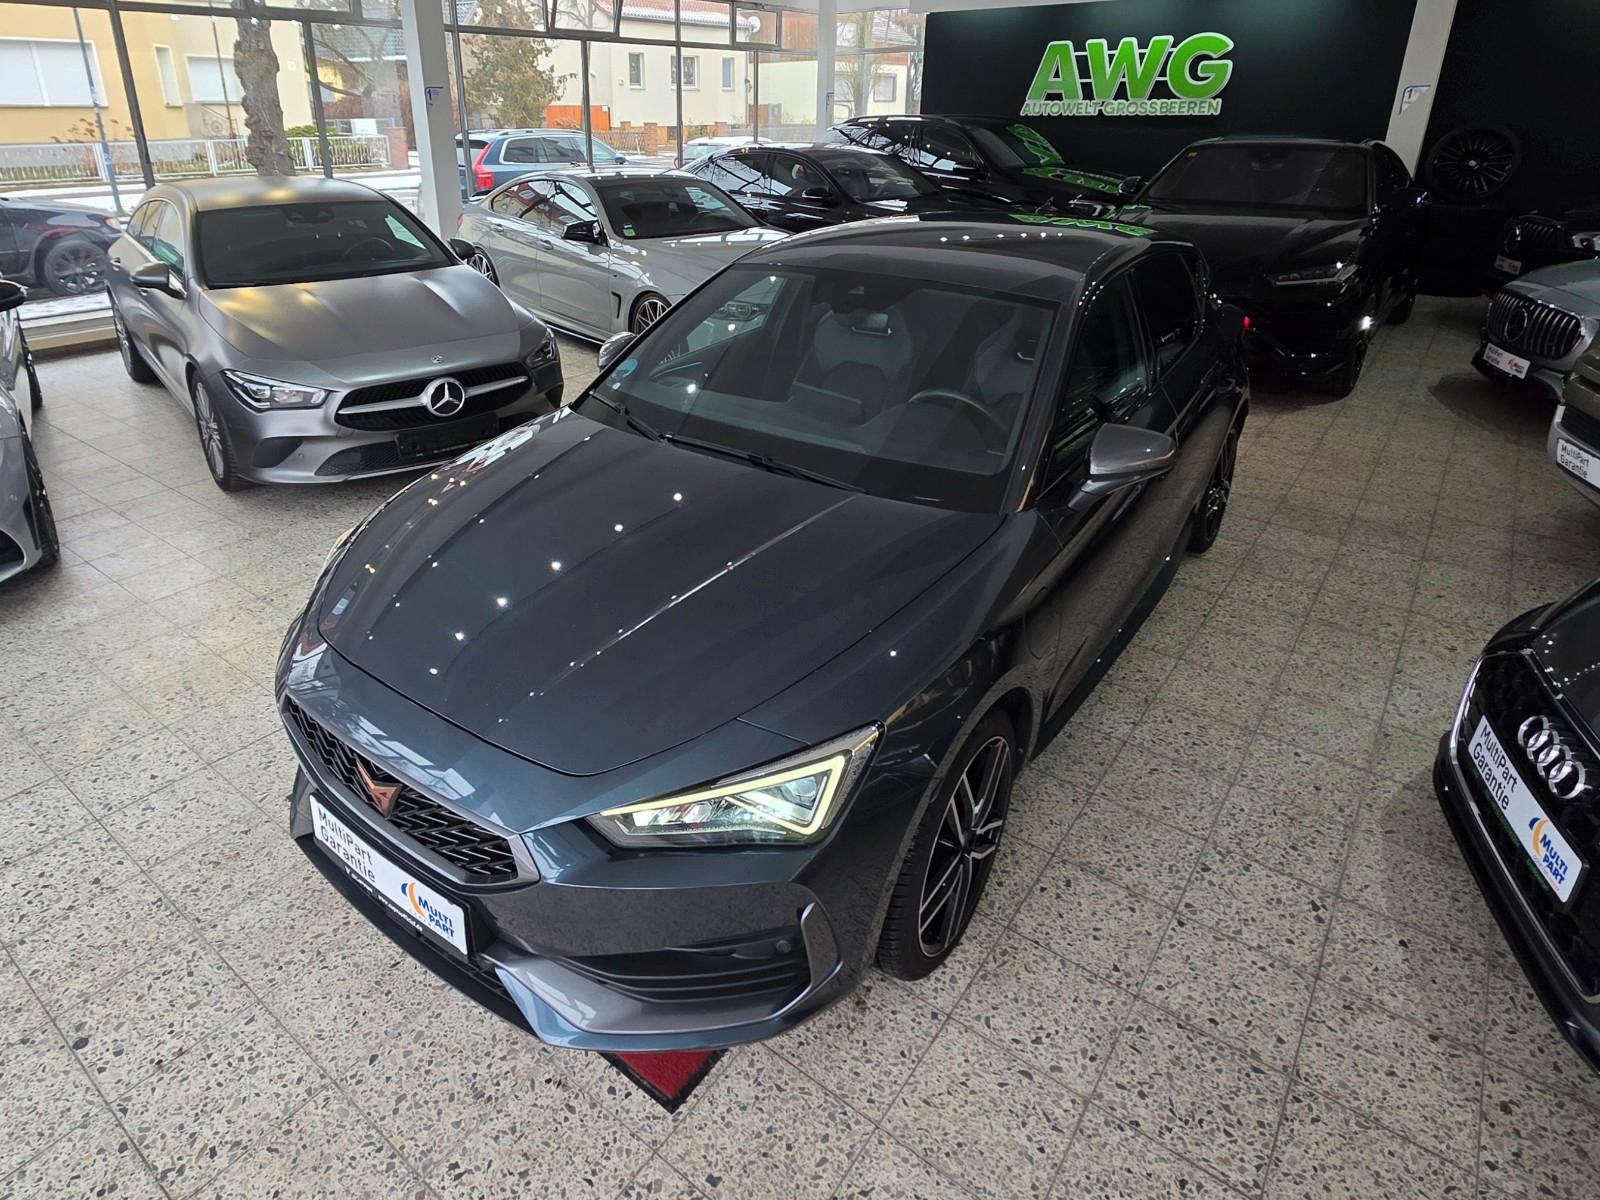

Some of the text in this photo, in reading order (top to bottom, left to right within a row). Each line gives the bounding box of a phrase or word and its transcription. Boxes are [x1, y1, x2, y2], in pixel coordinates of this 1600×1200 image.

[1026, 32, 1234, 101] AWG
[1021, 99, 1222, 116] AUTOWELT GROSSBEEREN
[1473, 742, 1510, 811] Garantie
[1480, 724, 1518, 793] MultiPart
[318, 807, 373, 866] MultiPart
[320, 825, 375, 882] Garantie
[1539, 833, 1569, 875] MULTI
[1542, 856, 1566, 885] PART
[418, 896, 453, 928] MULTI
[428, 917, 455, 938] PART
